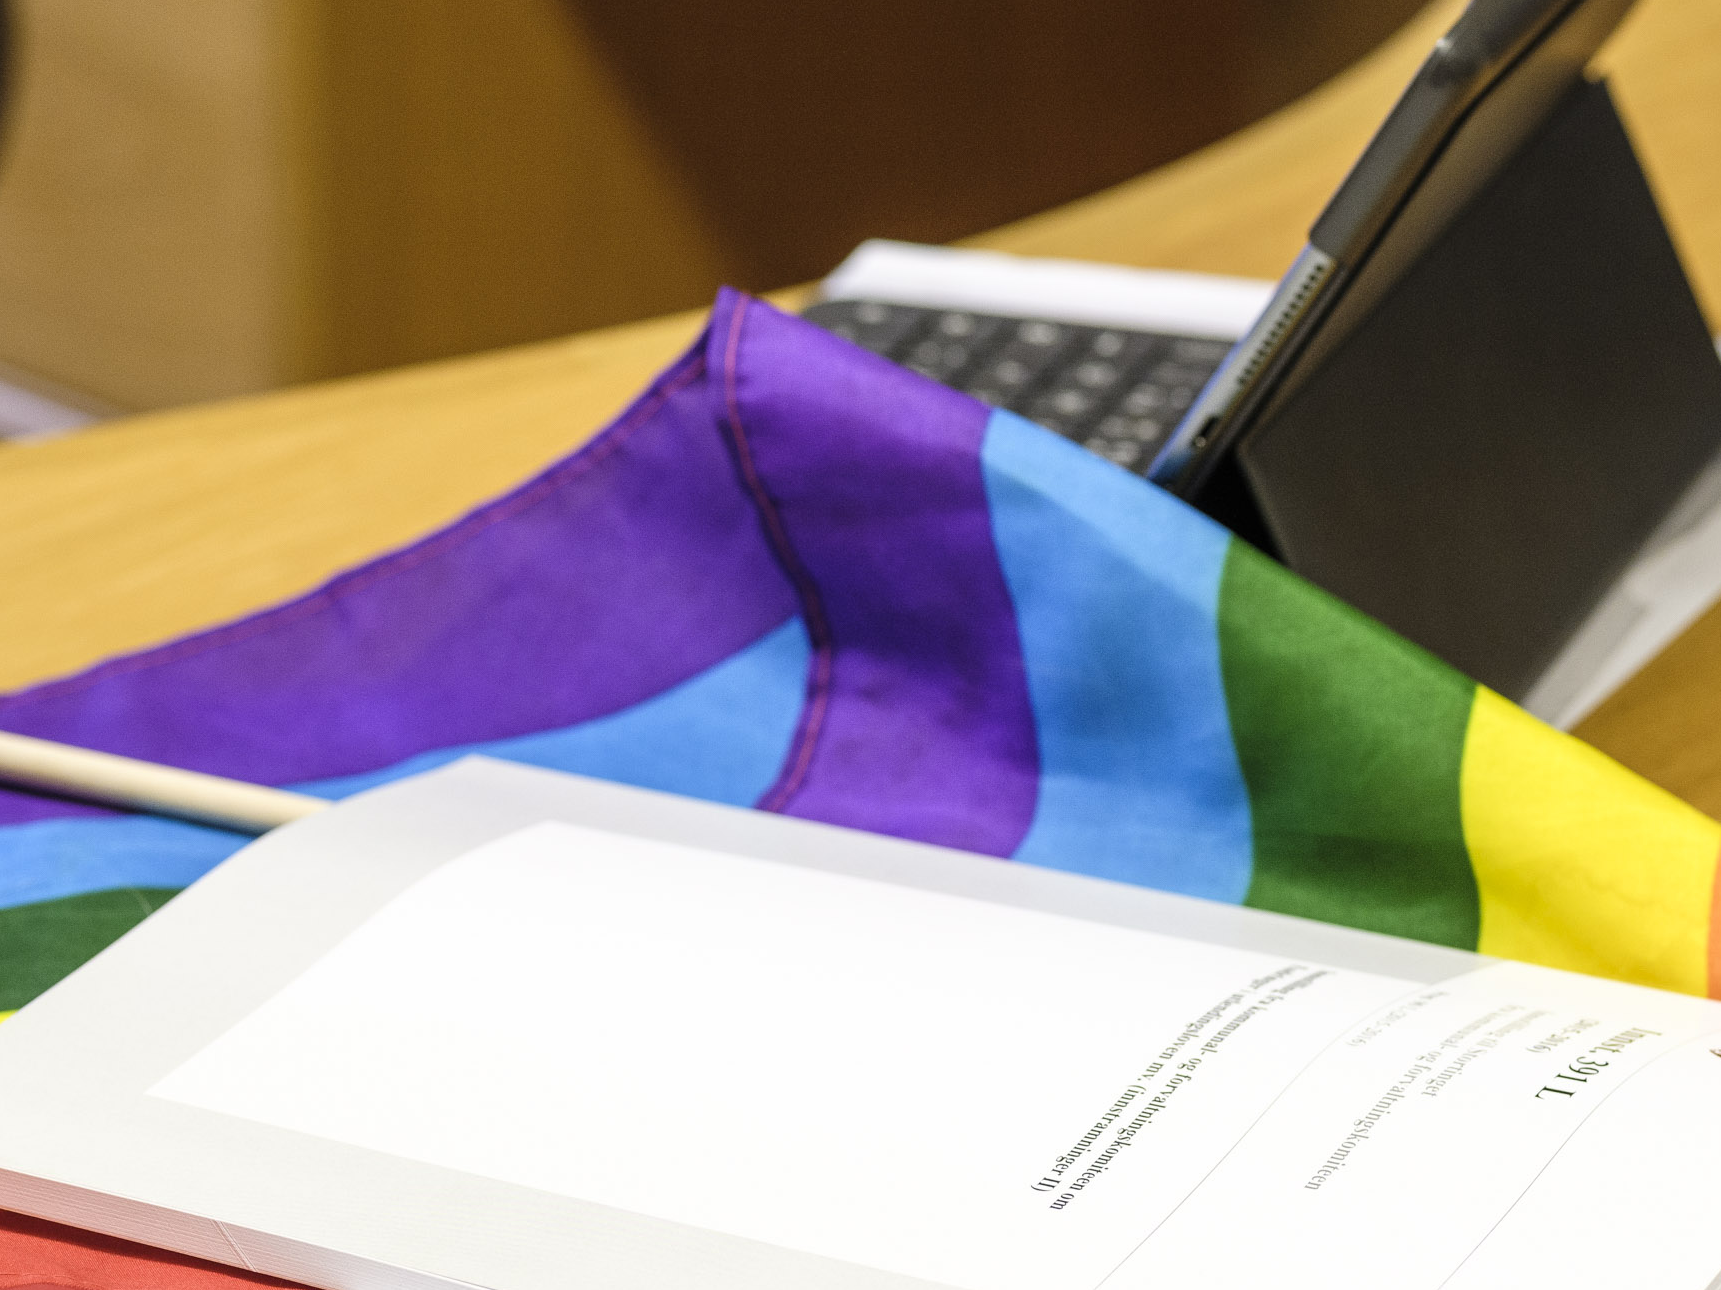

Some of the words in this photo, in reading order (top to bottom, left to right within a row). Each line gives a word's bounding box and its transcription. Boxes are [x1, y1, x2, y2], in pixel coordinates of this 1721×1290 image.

[1158, 992, 1242, 1061] utlendingsloven
[1199, 1005, 1268, 1056] kommunal-
[1590, 1026, 1664, 1056] Innst.
[1177, 1057, 1203, 1072] og
[1416, 1049, 1442, 1064] og
[1554, 1055, 1610, 1084] 391
[1135, 1061, 1164, 1083] mv.
[1420, 1046, 1488, 1099] Stortinget
[1534, 1084, 1578, 1101] L
[1054, 1084, 1147, 1177] (innstramninger
[1068, 1072, 1193, 1190] forvaltningskomiteen
[1304, 1062, 1434, 1191] forvaltningskomiteen
[1030, 1175, 1062, 1193] II)
[1048, 1192, 1076, 1210] om
